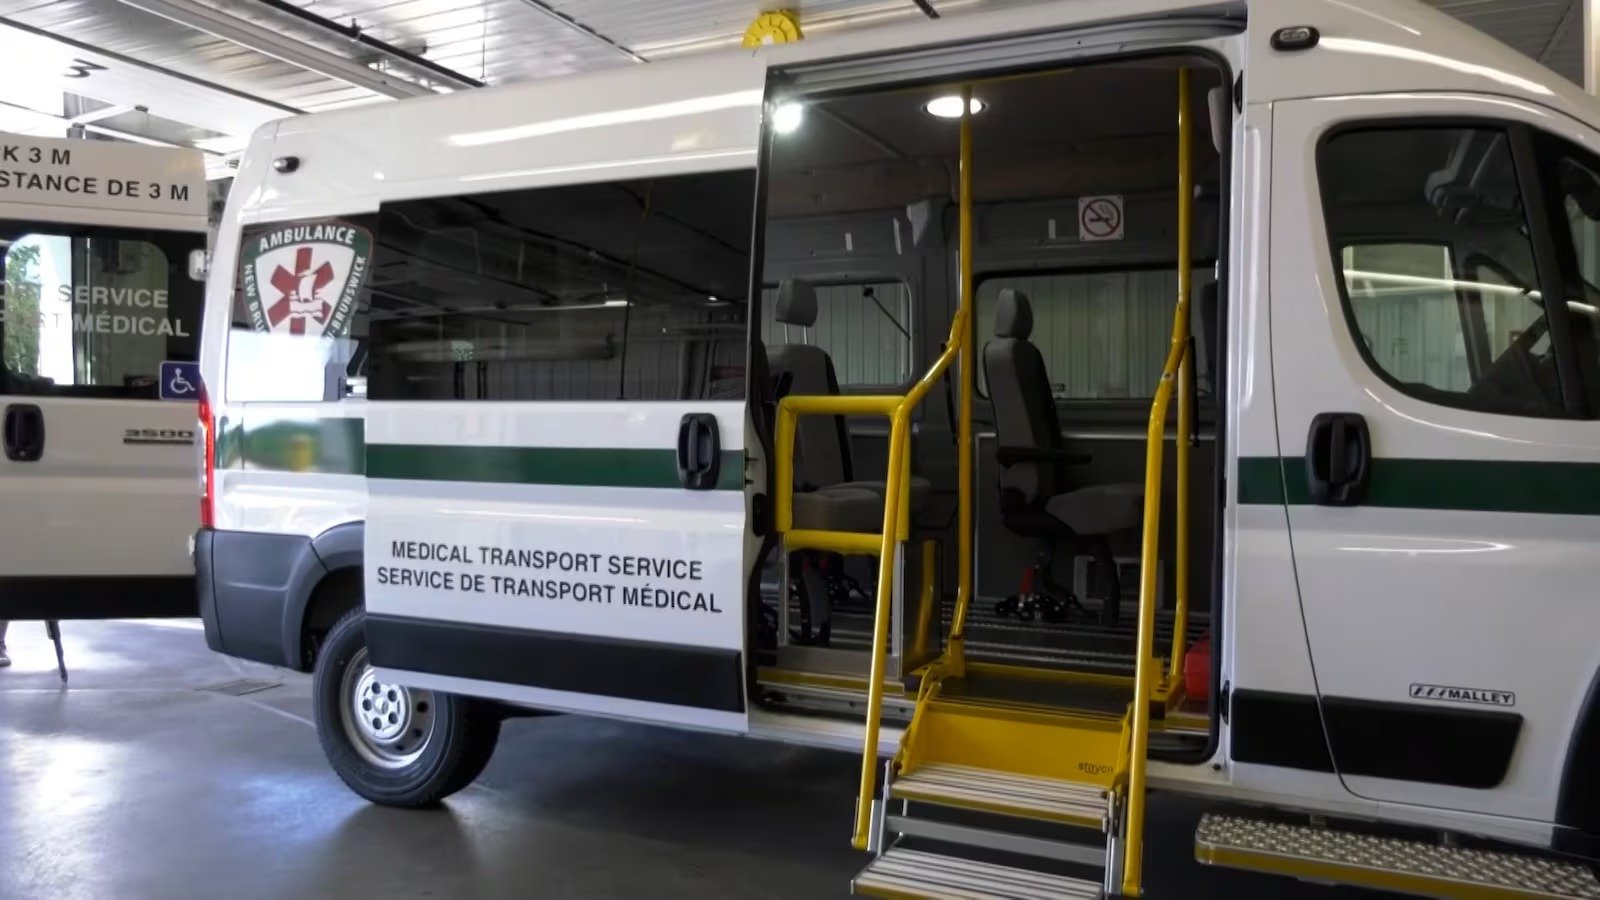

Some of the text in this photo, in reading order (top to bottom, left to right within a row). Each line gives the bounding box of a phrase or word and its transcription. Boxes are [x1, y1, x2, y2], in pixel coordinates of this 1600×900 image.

[28, 147, 42, 163] 3
[52, 148, 71, 165] M
[107, 179, 140, 197] DE
[149, 183, 161, 199] 3
[171, 184, 189, 201] M
[259, 225, 356, 251] AMBULANCE
[244, 264, 256, 296] NEW
[58, 284, 169, 308] SERVICE
[74, 310, 190, 337] MÉDICAL
[125, 429, 194, 438] 3500
[392, 540, 703, 580] MEDICAL TRANSPORT SERVICE
[377, 566, 723, 613] SERVICE DE TRANSPORT MÉDICAL
[1448, 689, 1511, 704] MALLEY
